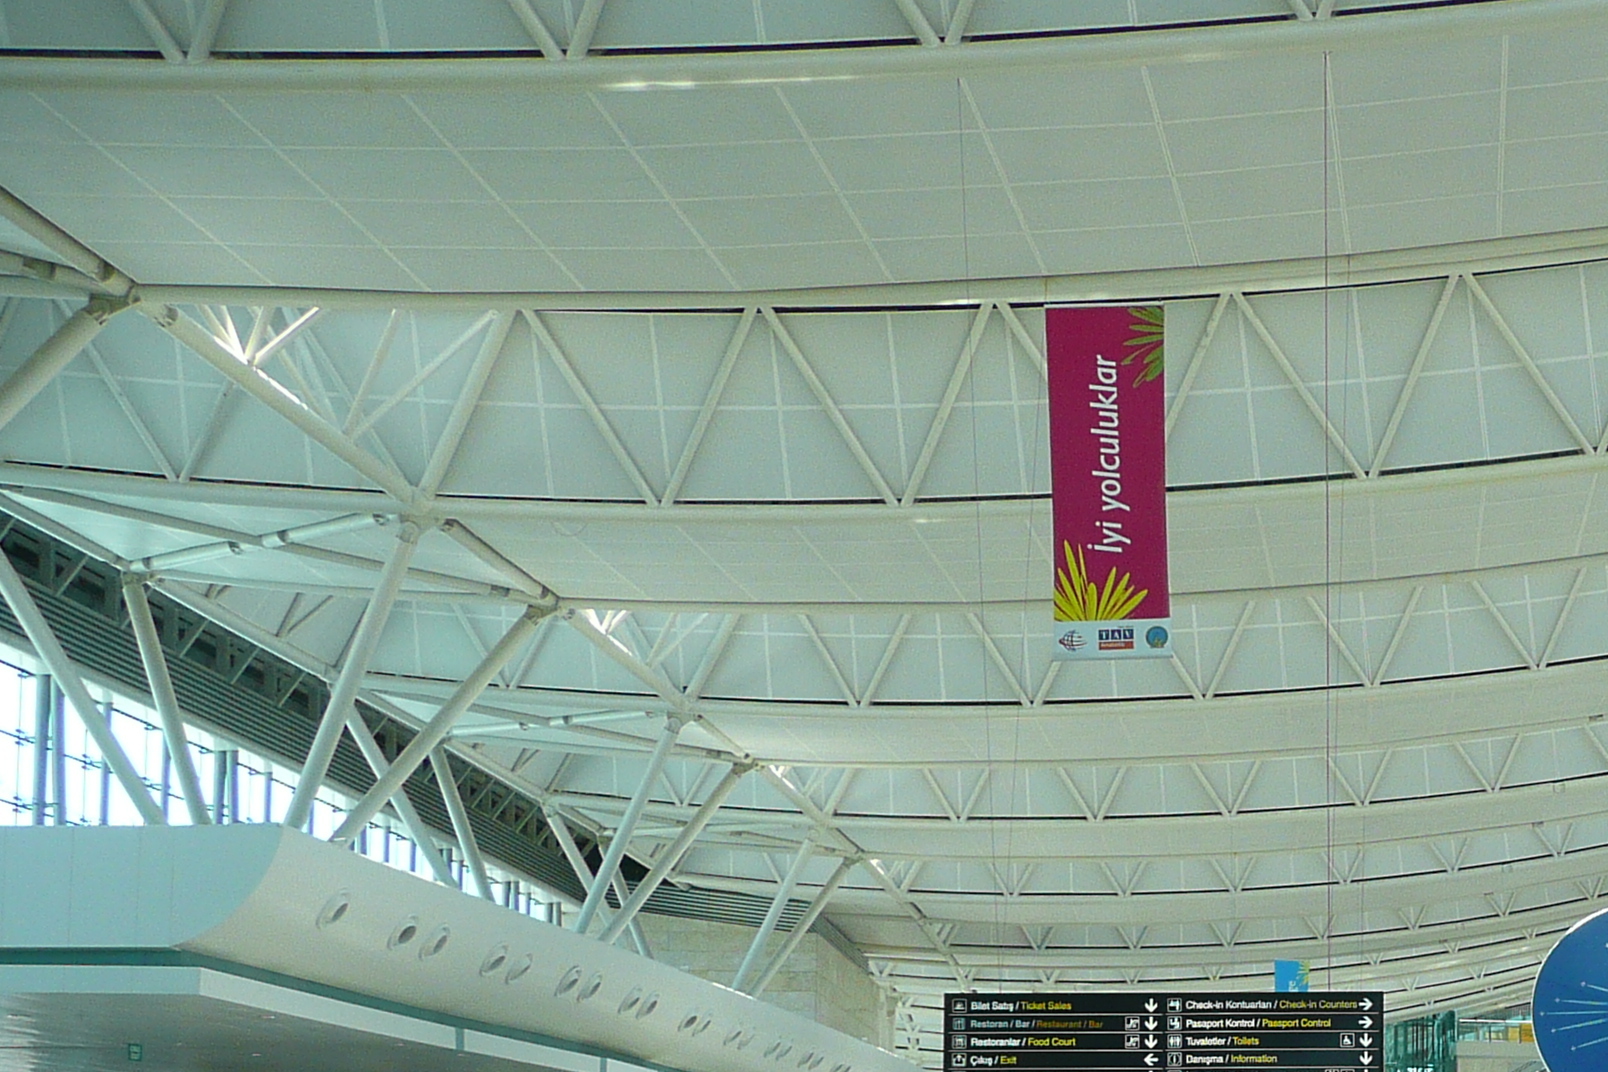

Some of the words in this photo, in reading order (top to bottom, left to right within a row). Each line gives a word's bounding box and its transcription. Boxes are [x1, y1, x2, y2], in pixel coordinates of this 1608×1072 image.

[1089, 354, 1131, 513] yolculuklar
[1088, 520, 1131, 553] İyi
[971, 1001, 991, 1010] Bilet
[1021, 1001, 1046, 1010] Ticket
[1048, 1001, 1072, 1010] Sales
[1186, 1000, 1223, 1009] Check-in
[1279, 1000, 1317, 1009] Check-in
[1319, 1000, 1357, 1009] Counters
[971, 1020, 1007, 1028] Restoran
[1015, 1020, 1030, 1028] Bar
[1037, 1020, 1082, 1028] Restaurant
[1089, 1020, 1103, 1028] Bar
[1186, 1019, 1224, 1029] Pasaport
[1226, 1018, 1254, 1027] Kontrol
[1262, 1018, 1299, 1029] Passport
[1301, 1018, 1331, 1027] Control
[971, 1038, 1021, 1047] Restoranlar
[1028, 1038, 1049, 1046] Food
[1052, 1038, 1076, 1046] Court
[1186, 1037, 1226, 1045] Tuvaletler
[1233, 1037, 1259, 1045] Toilets
[1000, 1056, 1017, 1065] Exit
[1186, 1054, 1223, 1066] Danışma
[1231, 1054, 1277, 1063] Information
